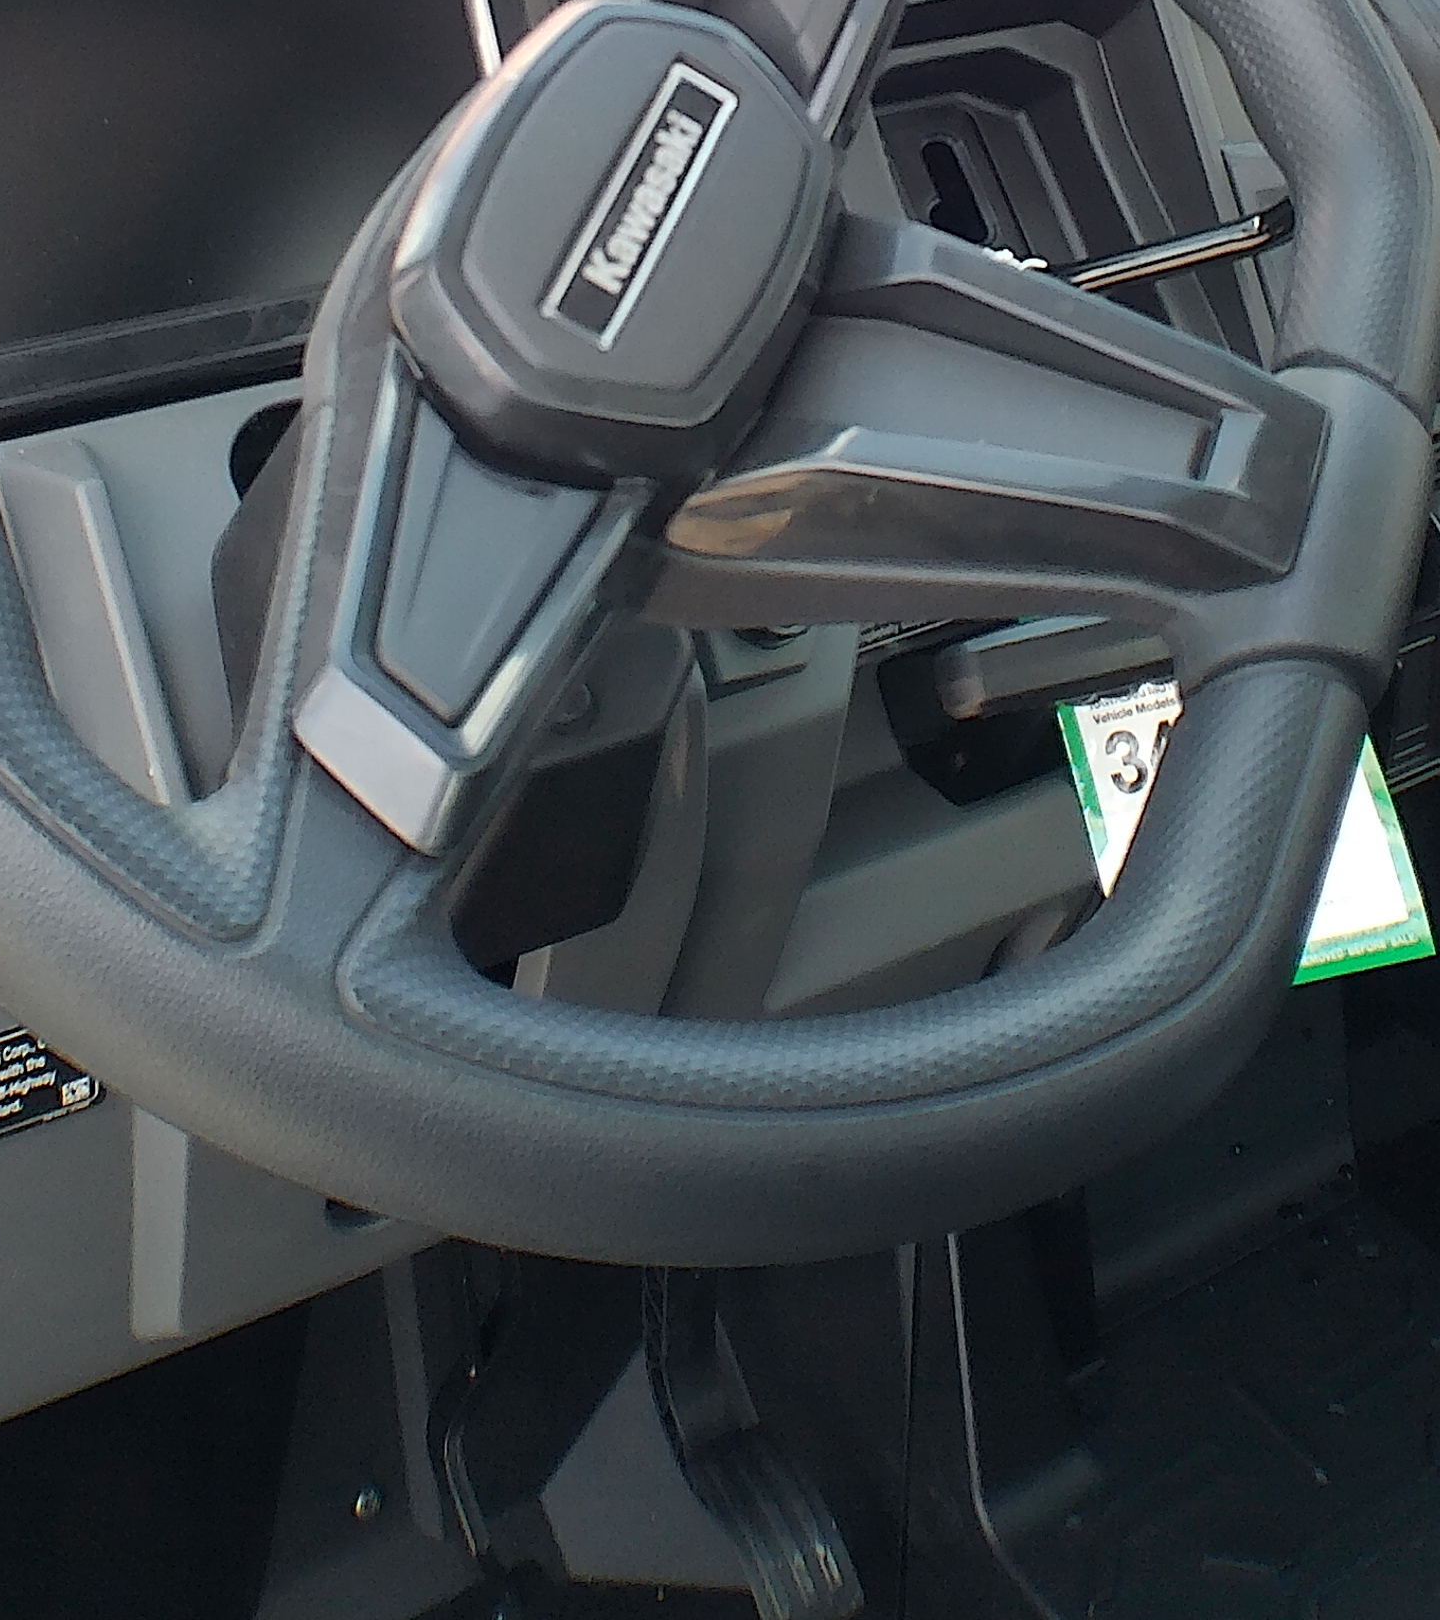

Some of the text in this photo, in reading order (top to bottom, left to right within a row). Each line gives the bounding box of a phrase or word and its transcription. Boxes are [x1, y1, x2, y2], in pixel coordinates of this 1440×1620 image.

[581, 108, 704, 295] Kawasaki
[1092, 696, 1178, 725] Vehicle Models
[25, 1055, 47, 1072] the
